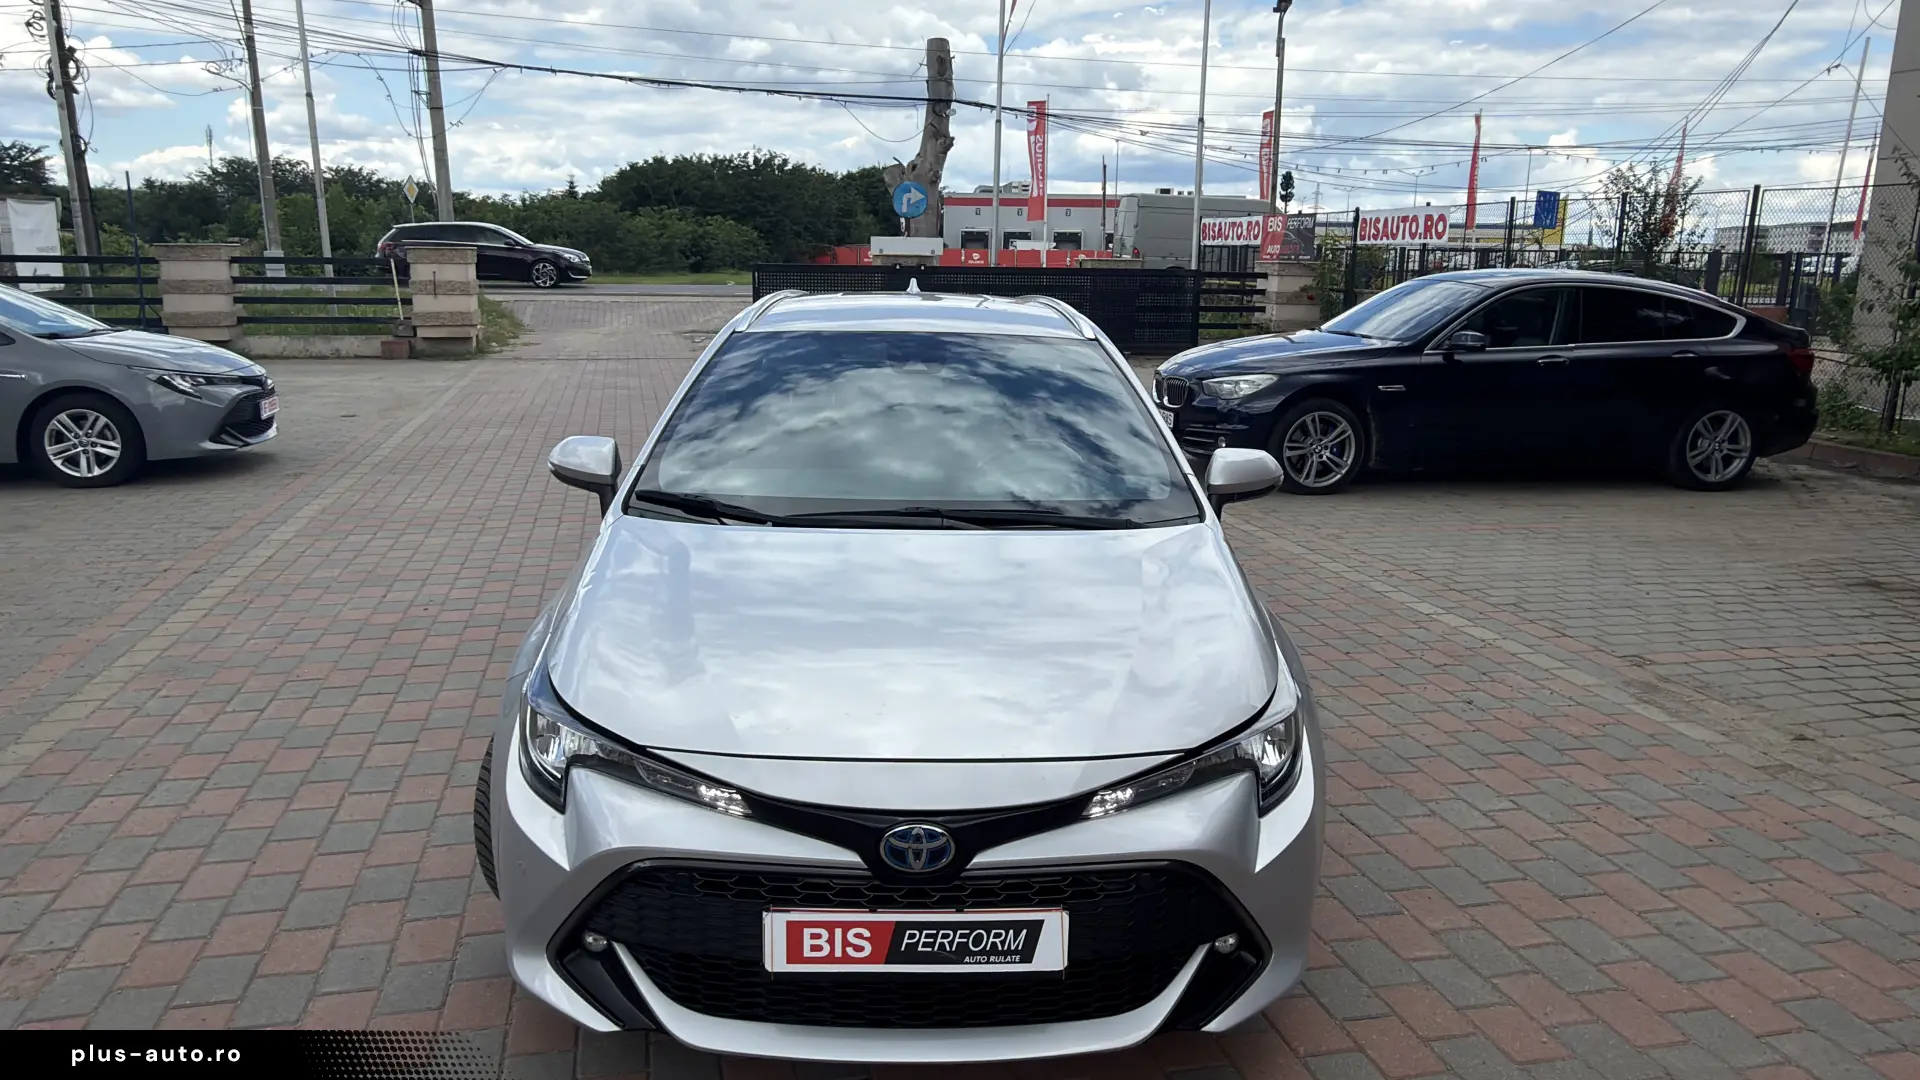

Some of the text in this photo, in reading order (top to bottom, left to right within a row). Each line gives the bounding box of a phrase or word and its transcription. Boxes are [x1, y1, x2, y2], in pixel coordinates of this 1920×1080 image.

[1201, 219, 1261, 241] BISAUTO.RO
[1267, 216, 1283, 232] BIS
[1359, 213, 1448, 241] BISAUTO.RO
[803, 927, 1028, 958] BIS PERFORM
[963, 955, 1021, 963] AUTO RULATE
